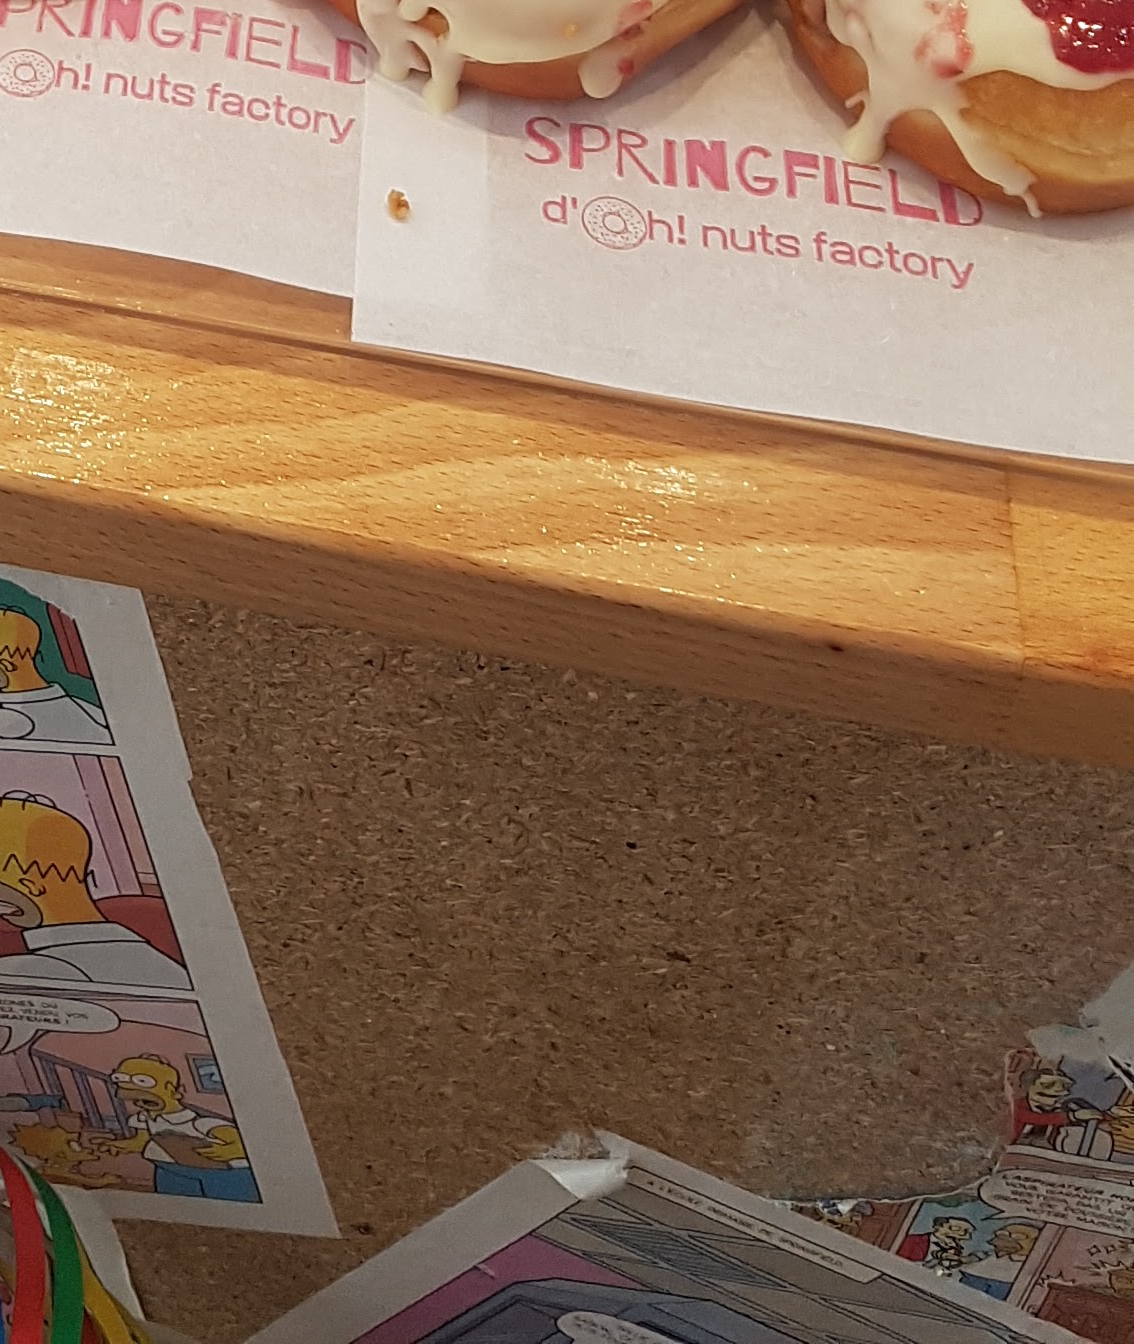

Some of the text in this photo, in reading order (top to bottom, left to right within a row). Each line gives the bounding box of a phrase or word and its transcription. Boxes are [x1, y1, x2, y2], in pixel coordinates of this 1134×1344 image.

[103, 68, 196, 110] nuts
[205, 81, 356, 146] factory
[523, 115, 985, 227] SPRINGFIELD
[701, 220, 802, 260] nuts
[812, 230, 976, 291] factory
